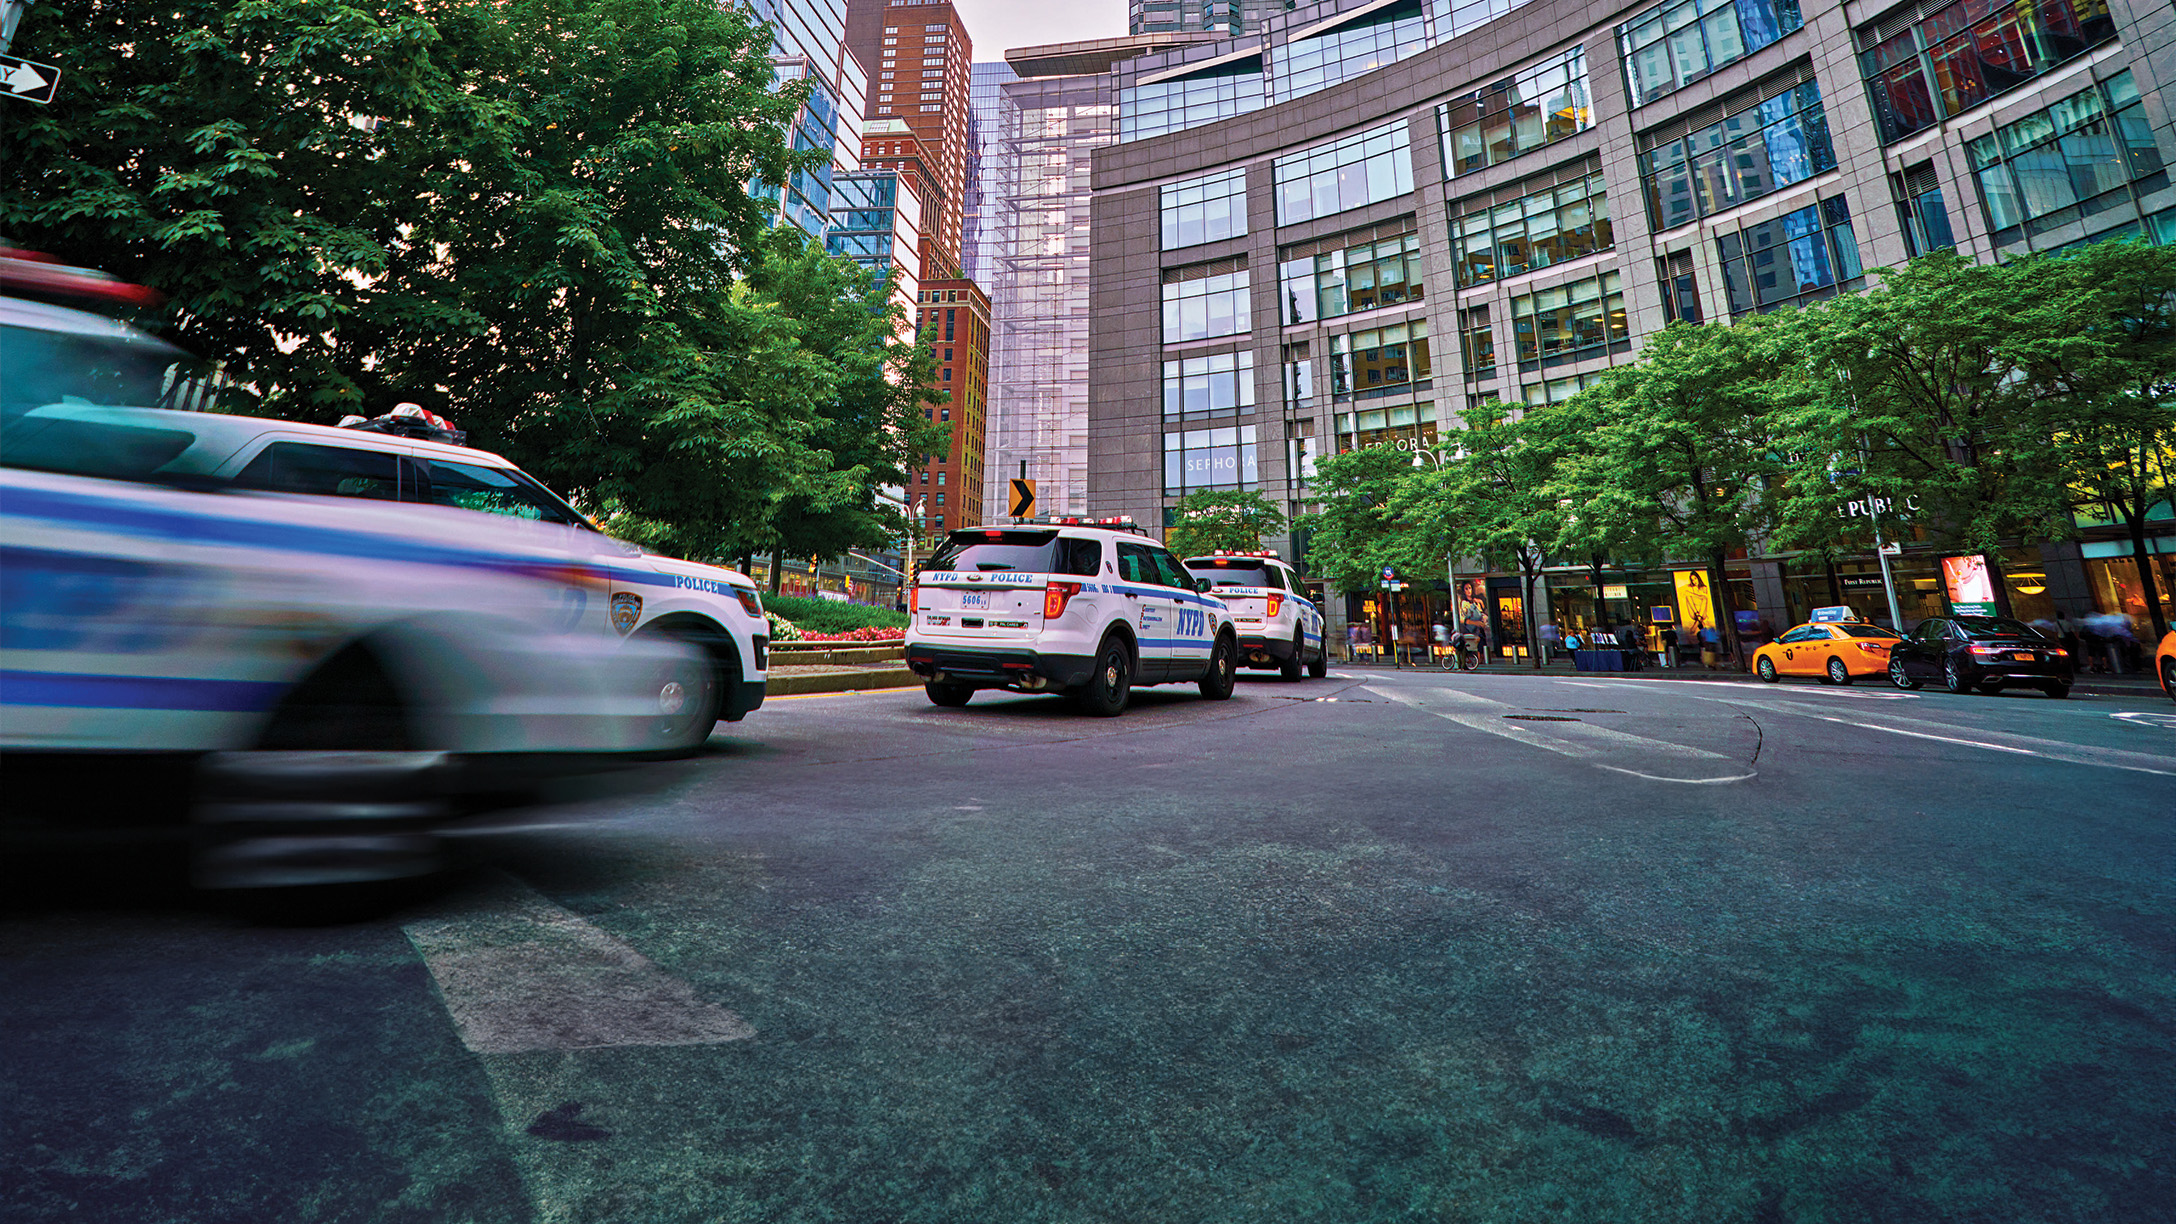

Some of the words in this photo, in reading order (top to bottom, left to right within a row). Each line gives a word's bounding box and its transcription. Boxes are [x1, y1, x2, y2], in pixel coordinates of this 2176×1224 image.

[1187, 455, 1256, 472] SEPHOA
[932, 572, 959, 582] NYPD
[990, 573, 1034, 583] POLICE
[676, 575, 719, 594] POLICE
[962, 595, 981, 605] 5606
[1176, 607, 1205, 637] NYPD
